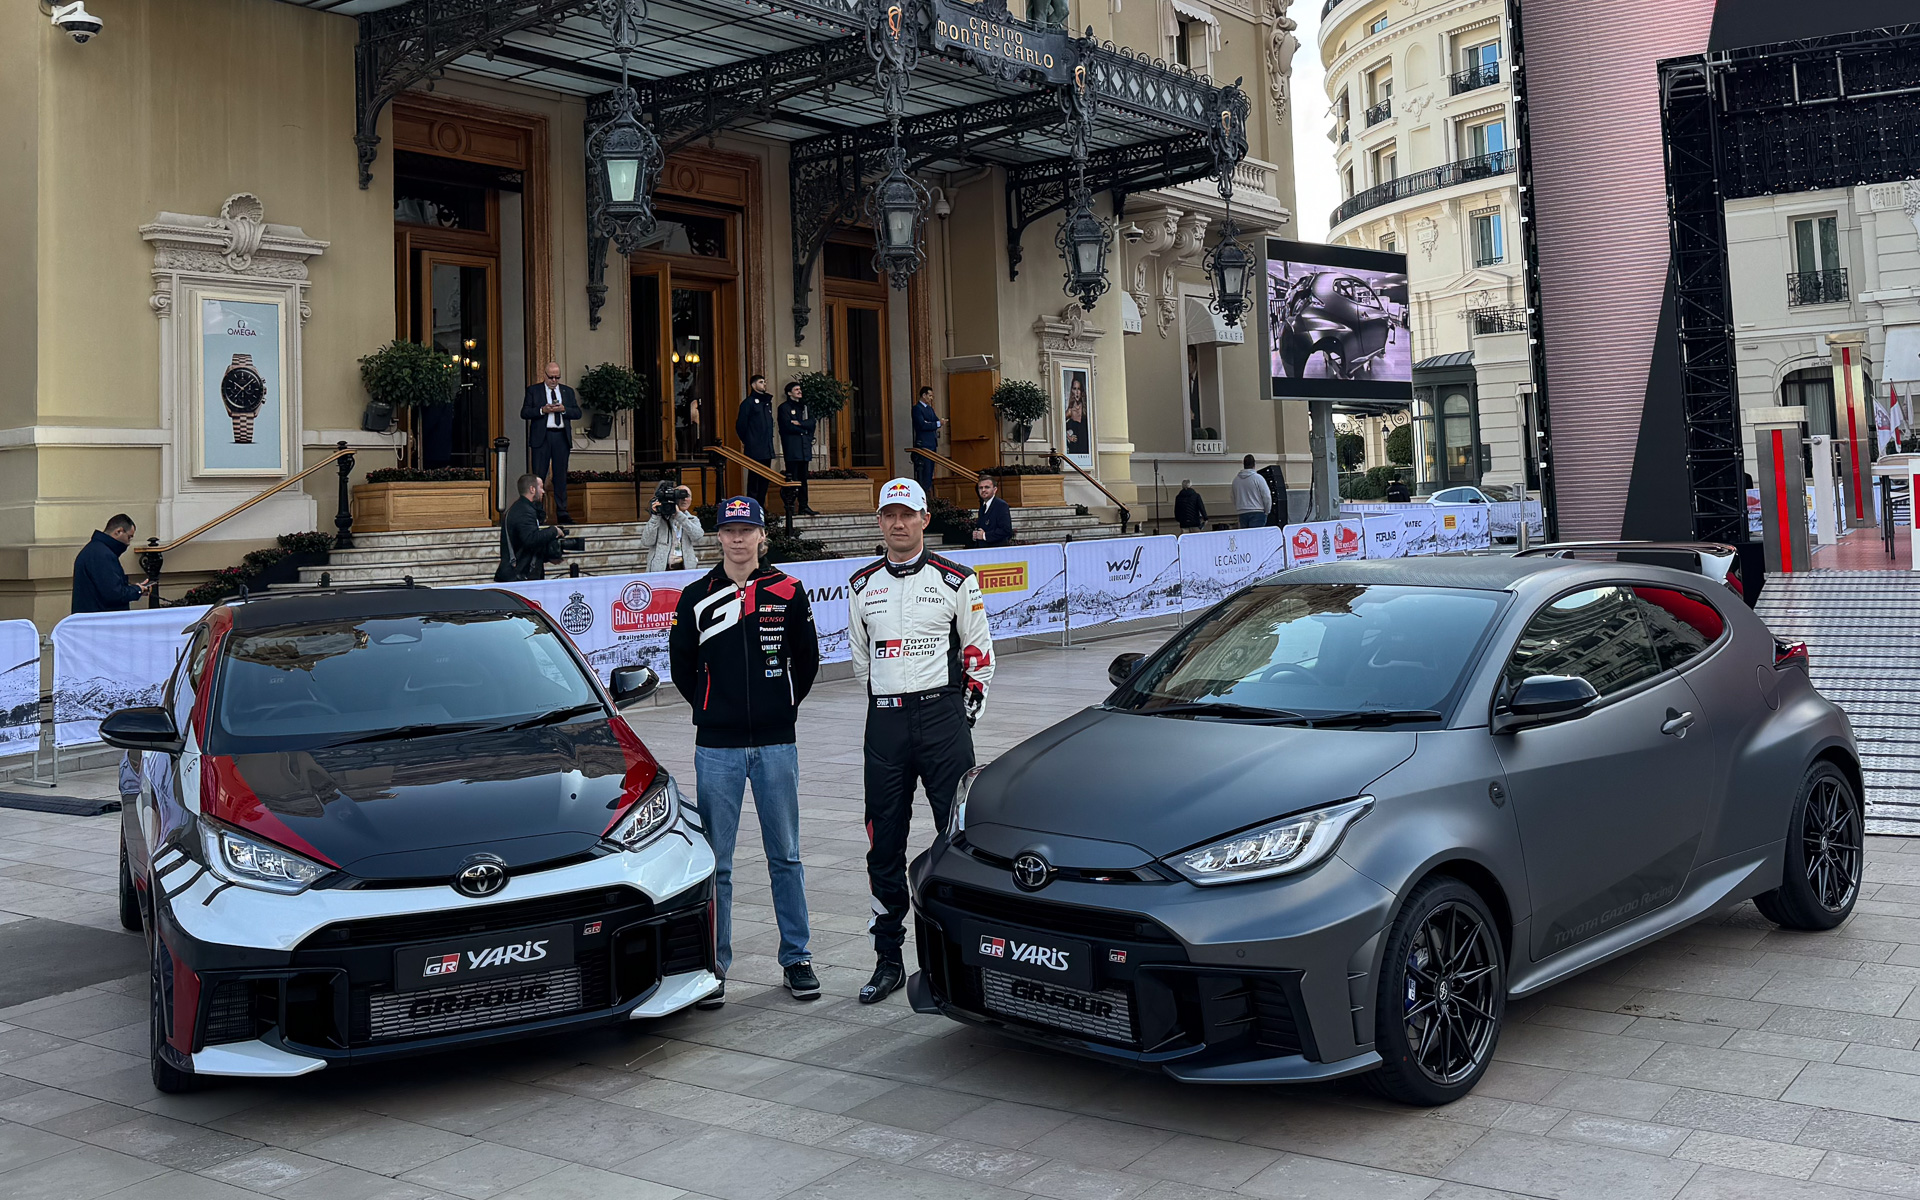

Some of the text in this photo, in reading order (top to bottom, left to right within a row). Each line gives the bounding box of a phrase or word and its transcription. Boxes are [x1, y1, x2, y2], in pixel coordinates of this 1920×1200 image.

[969, 17, 1023, 45] CASINO
[937, 20, 1054, 69] MONTE-CARLO
[227, 328, 257, 337] OMEGA
[1196, 443, 1223, 453] GRAFF
[1214, 552, 1251, 567] LE CASINO
[945, 573, 963, 587] OMP
[979, 566, 1024, 589] PIRELLI
[866, 587, 889, 598] DENSO
[615, 608, 644, 626] RALLYE
[876, 646, 900, 659] GR
[1554, 918, 1599, 945] TOYOTA
[1640, 884, 1674, 907] Racing
[584, 926, 600, 934] GR
[980, 943, 1004, 956] GR
[1110, 954, 1125, 962] GR
[425, 961, 458, 975] GR
